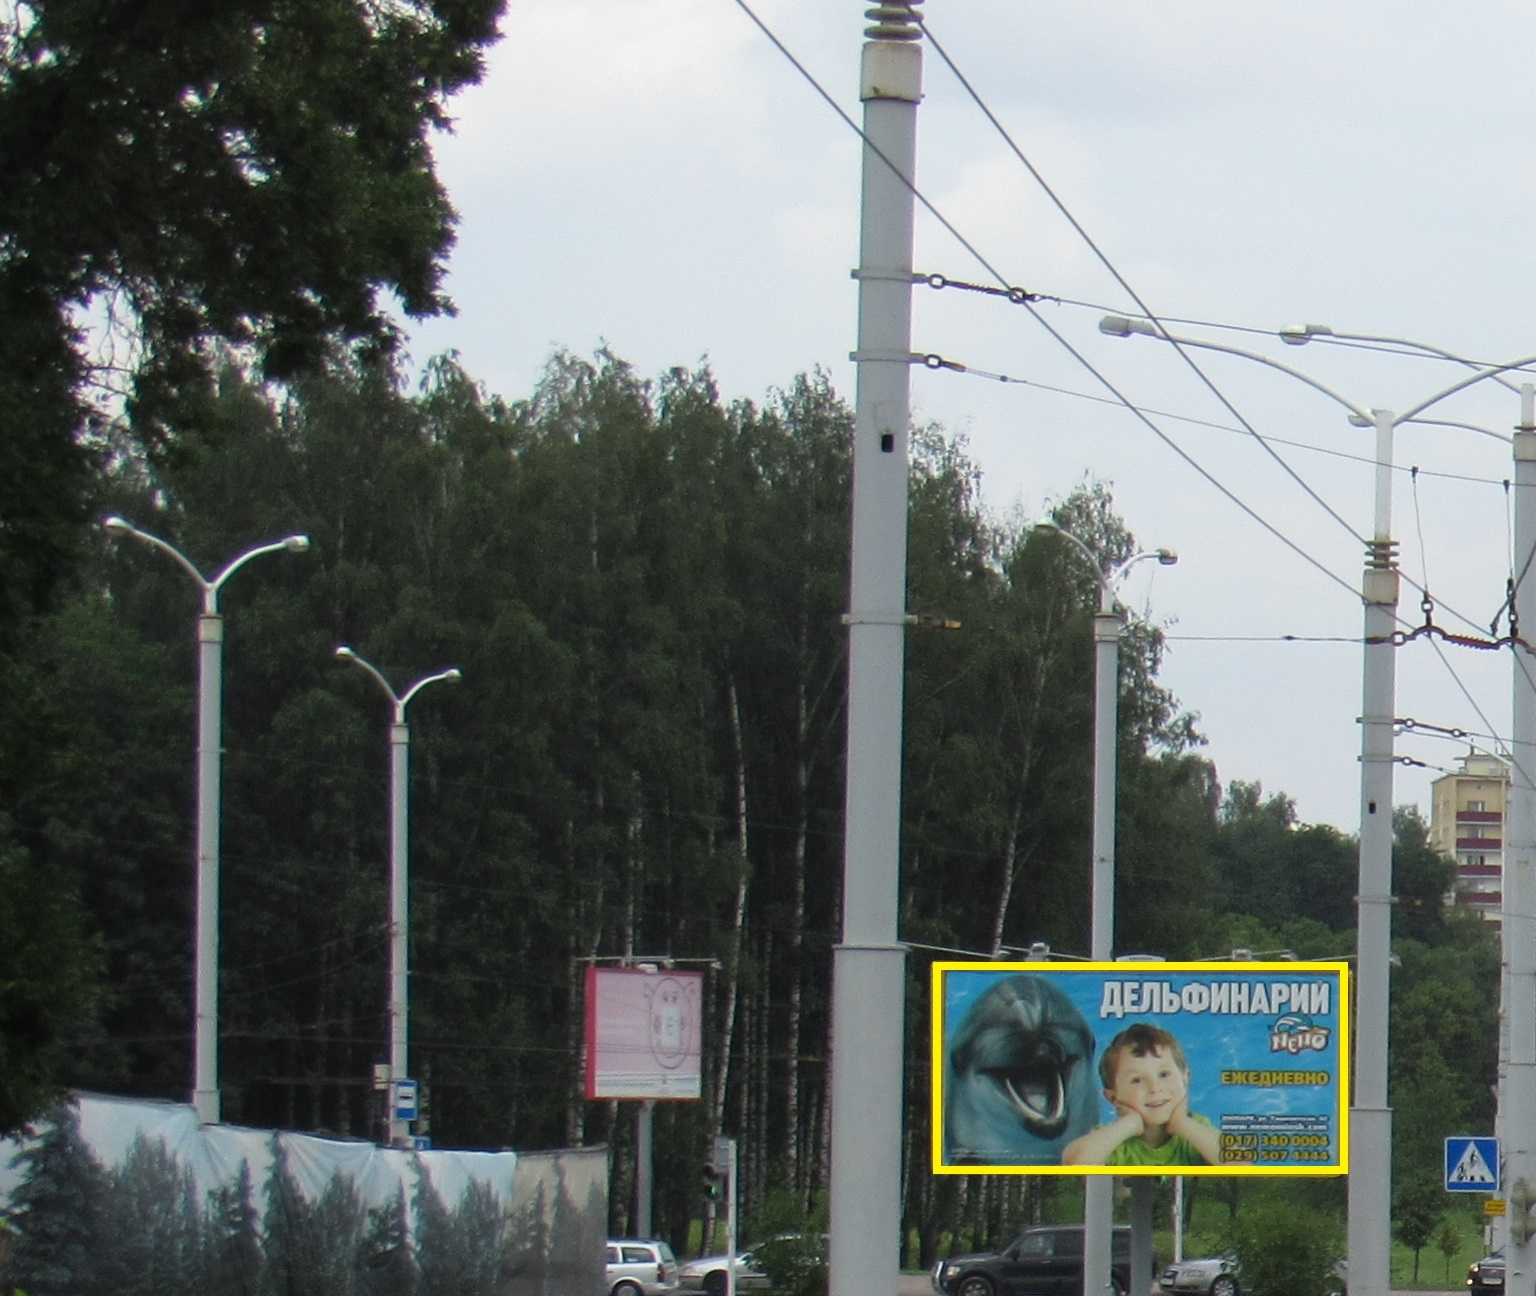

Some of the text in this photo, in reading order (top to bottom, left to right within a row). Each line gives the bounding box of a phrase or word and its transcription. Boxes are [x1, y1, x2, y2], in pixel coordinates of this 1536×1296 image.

[1101, 981, 1330, 1018] ДЕЛЬФИНАРИЙ
[1221, 1071, 1329, 1086] ЕЖЕДНЕВНО
[1221, 1134, 1328, 1147] (017) 340 0004
[1221, 1149, 1257, 1162] (029)
